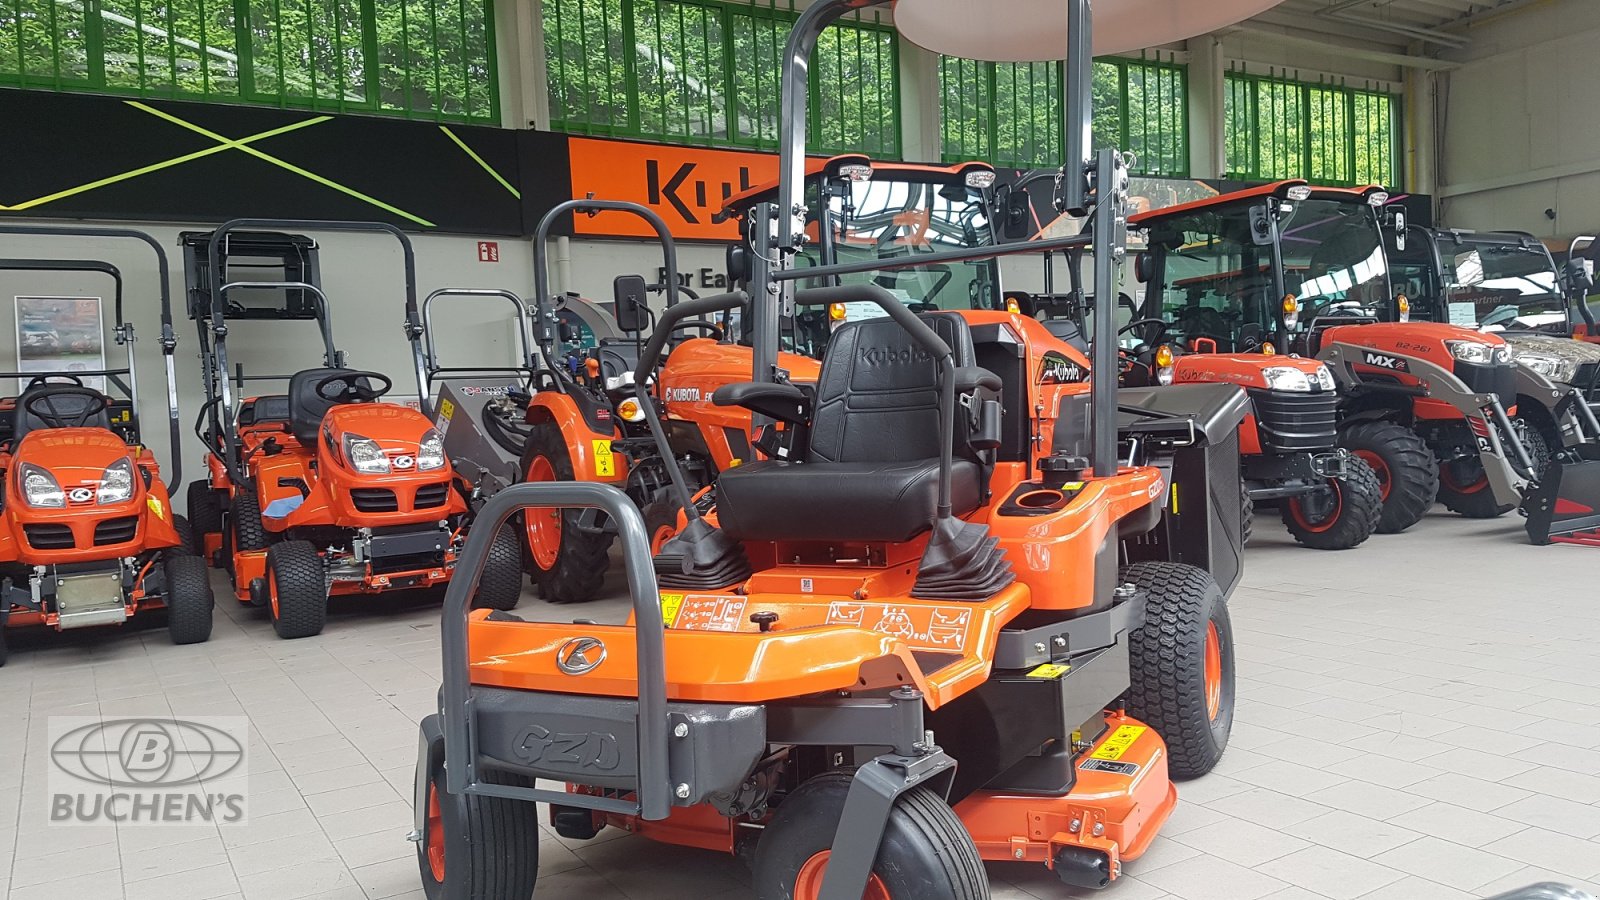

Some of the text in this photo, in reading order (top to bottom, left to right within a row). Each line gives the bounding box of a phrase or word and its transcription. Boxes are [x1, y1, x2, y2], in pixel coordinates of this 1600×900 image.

[700, 267, 730, 289] Ea
[860, 346, 928, 366] Kubota
[1366, 353, 1396, 369] MX
[1054, 362, 1079, 381] Kubota
[672, 387, 700, 402] KUBOTA
[512, 724, 621, 771] GZD
